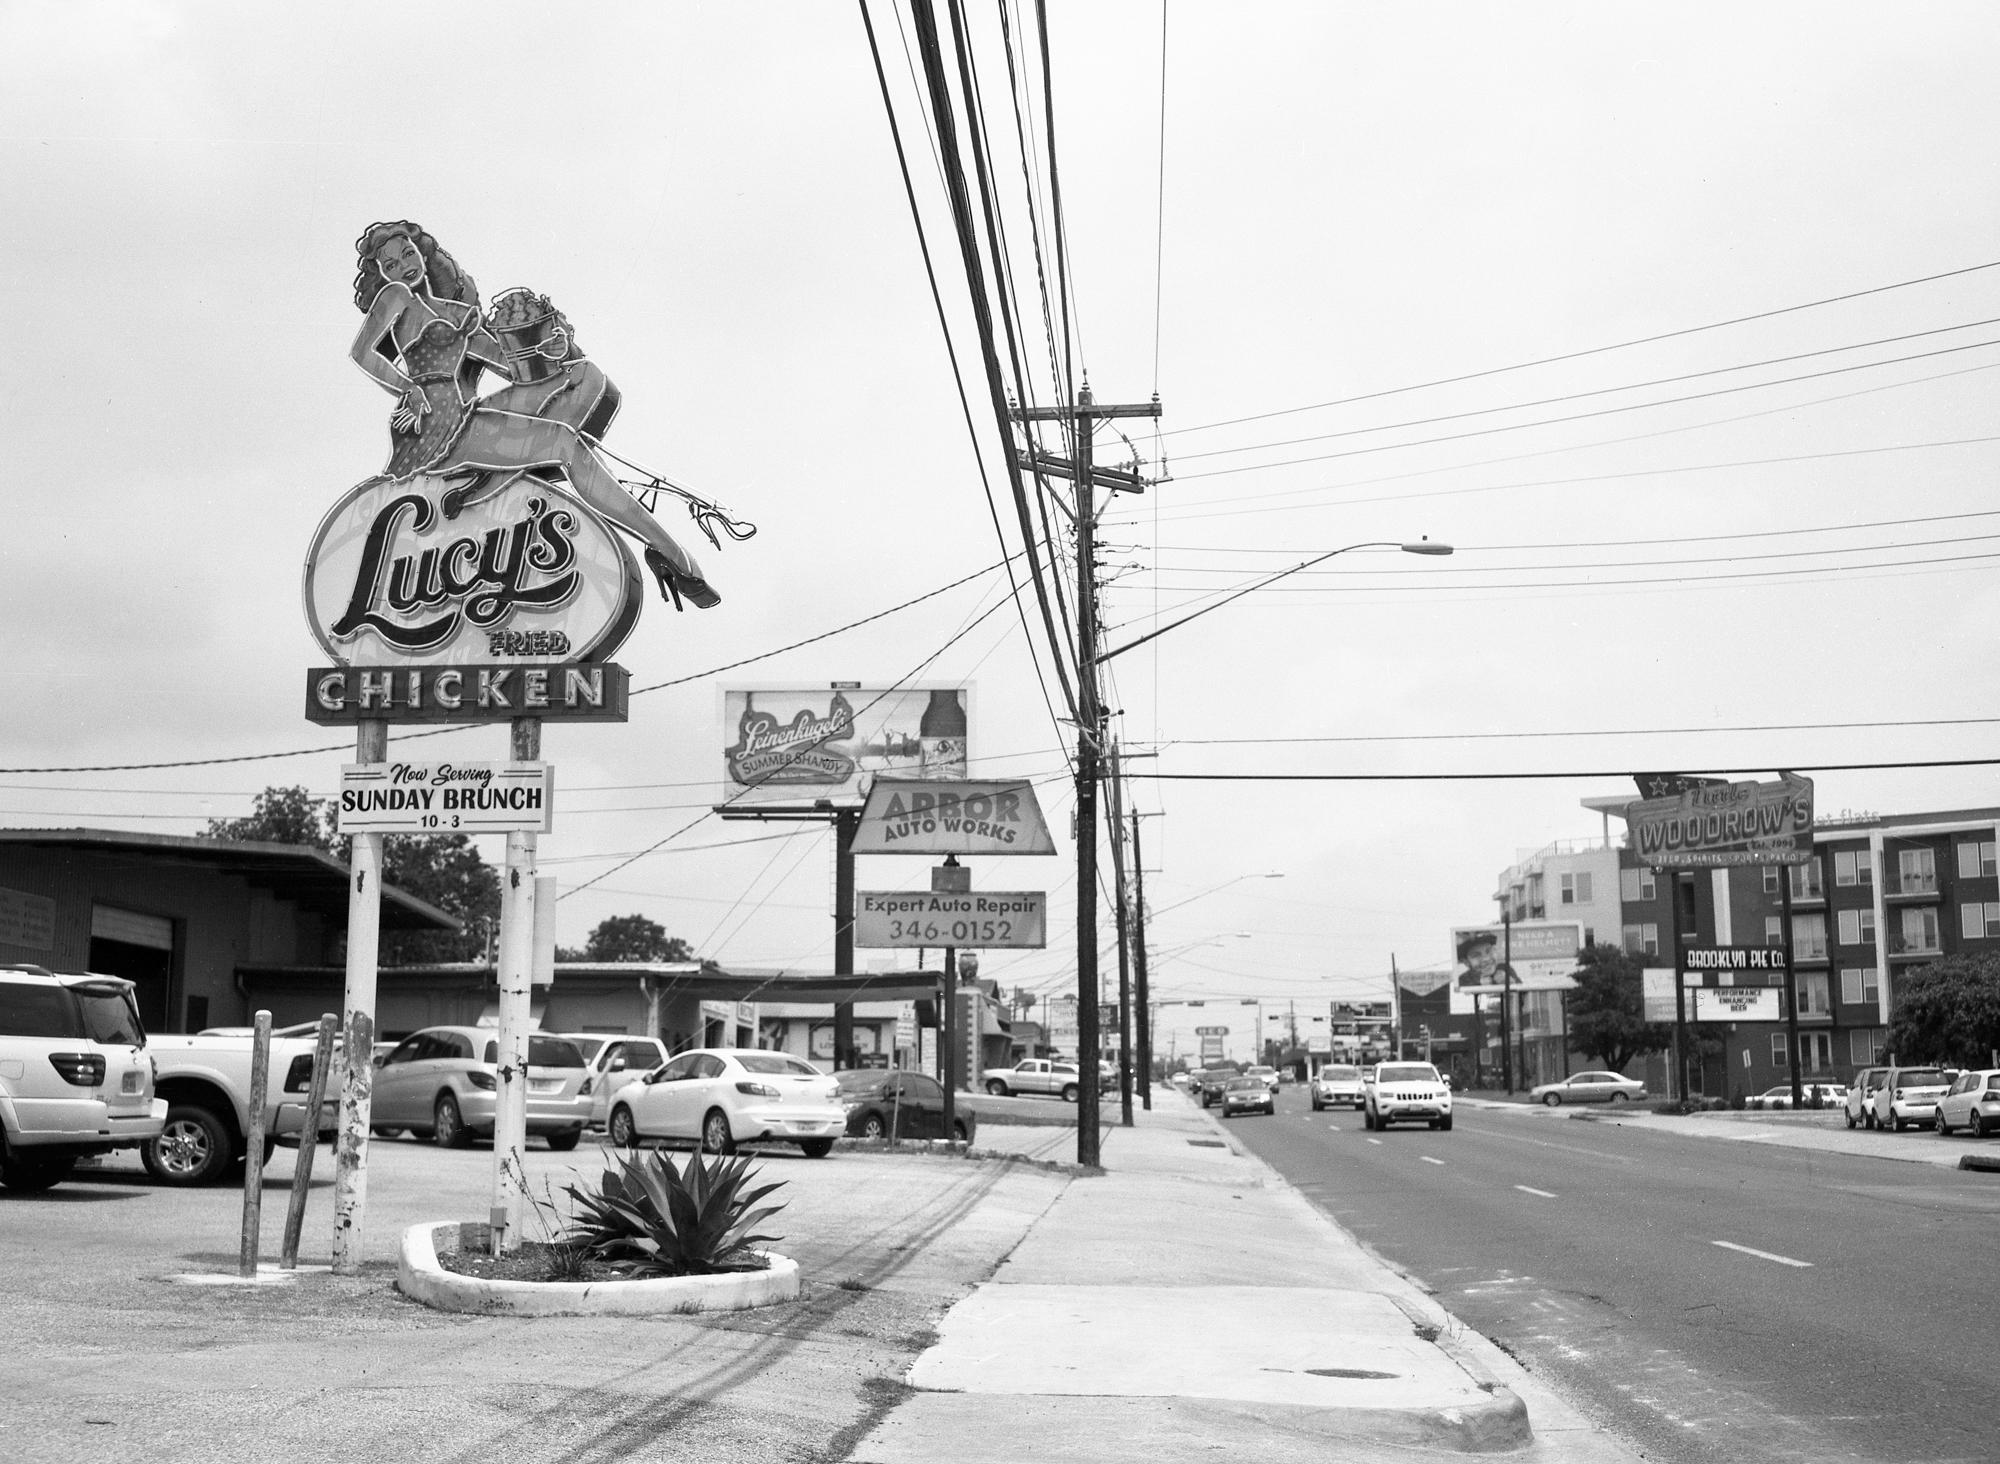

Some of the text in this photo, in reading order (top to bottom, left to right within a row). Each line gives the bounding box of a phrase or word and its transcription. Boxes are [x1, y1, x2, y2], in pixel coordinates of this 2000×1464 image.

[331, 495, 580, 652] Lucy's
[486, 630, 570, 656] FRIED
[316, 668, 603, 711] CHICKEN
[390, 763, 494, 788] Now Serving
[742, 752, 843, 775] SUMMER SHANDY
[342, 787, 542, 811] SUNDAY BRUNCH
[882, 792, 1021, 823] ARBOR
[885, 819, 1017, 844] AUTO WORKS
[1641, 798, 1810, 855] WOODROW'S
[865, 898, 1036, 916] Expert Auto Repair
[890, 920, 1012, 941] 346-0152
[1688, 950, 1747, 968] BROOKLYN
[1751, 950, 1768, 968] PIE
